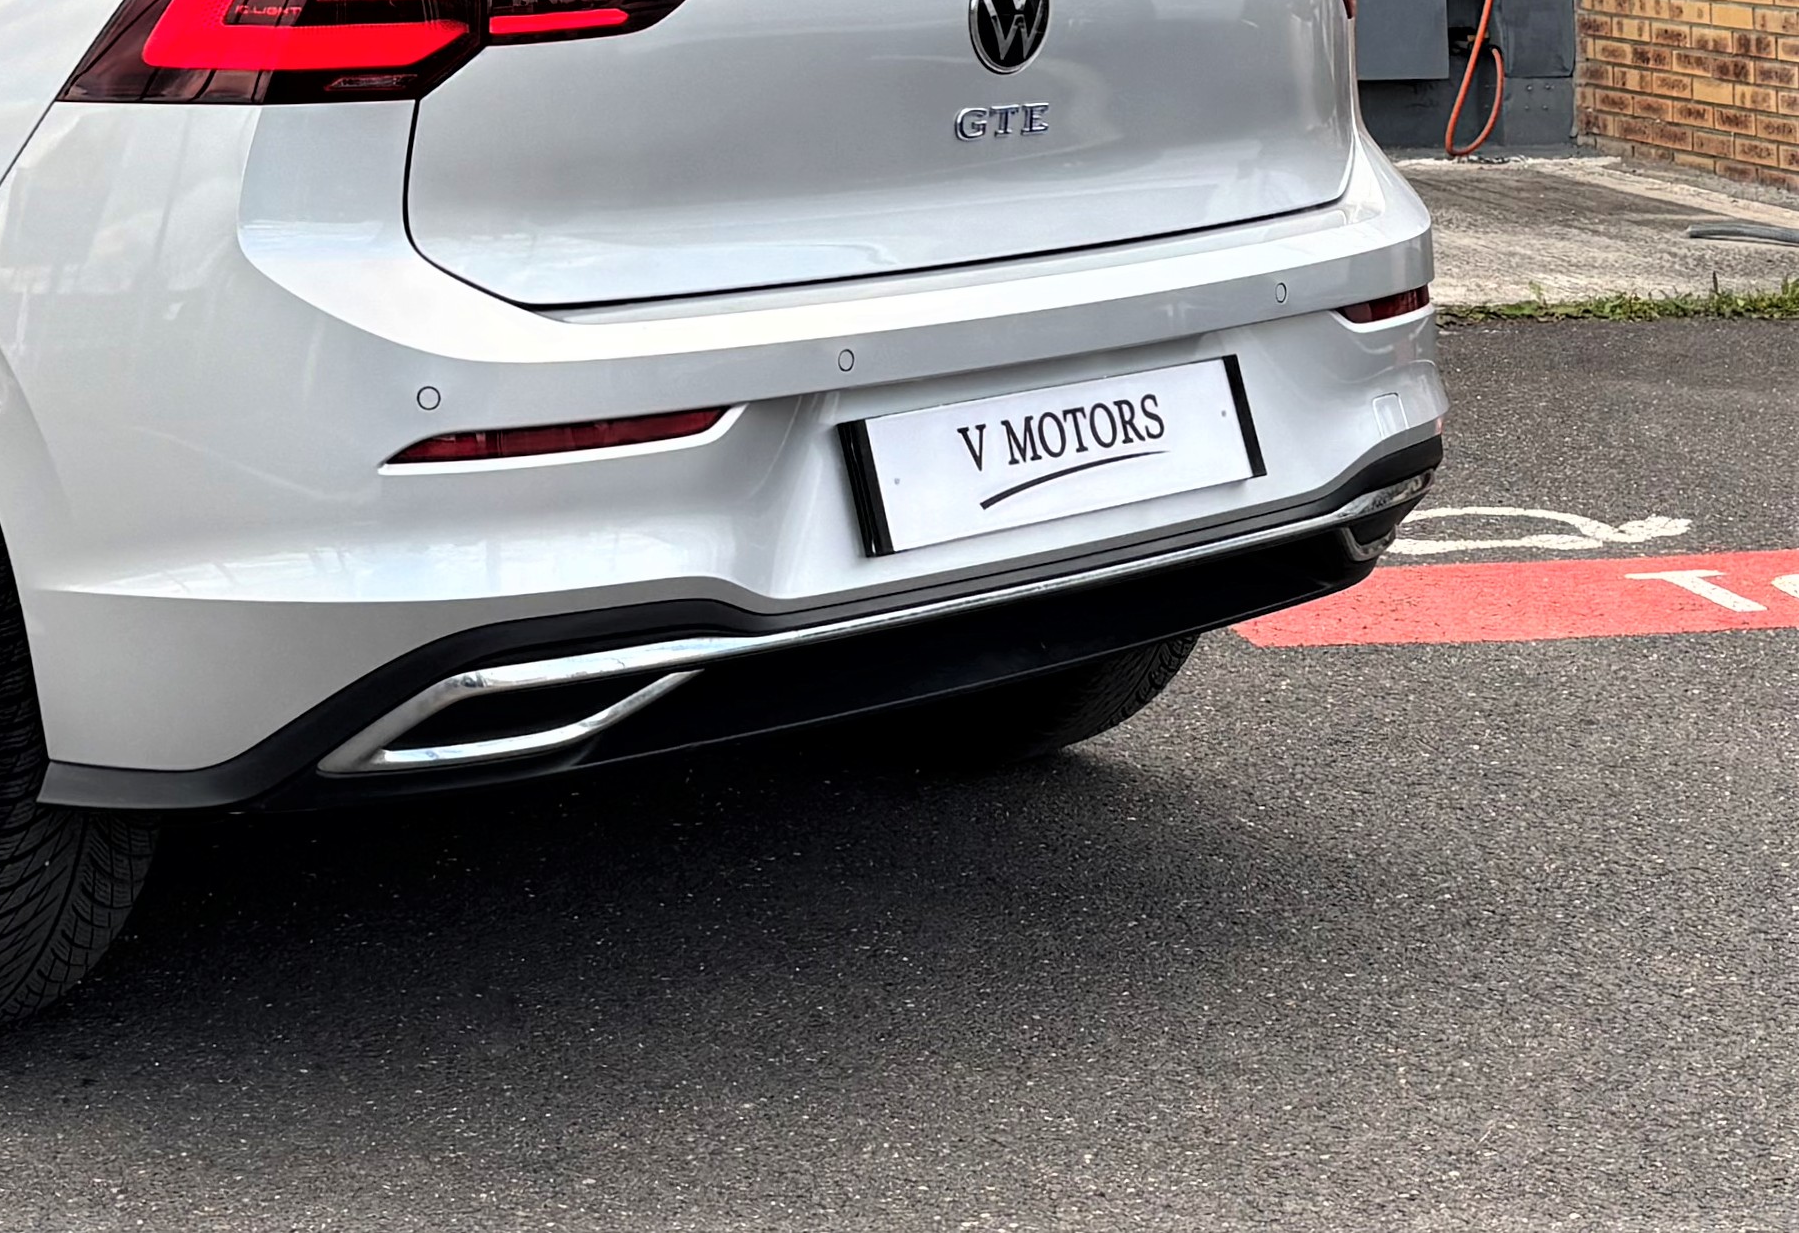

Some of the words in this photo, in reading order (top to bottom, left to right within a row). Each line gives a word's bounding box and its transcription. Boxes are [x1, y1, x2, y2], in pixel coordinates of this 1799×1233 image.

[954, 102, 1050, 142] GTE
[956, 423, 987, 472] V
[1000, 393, 1165, 465] MOTORS
